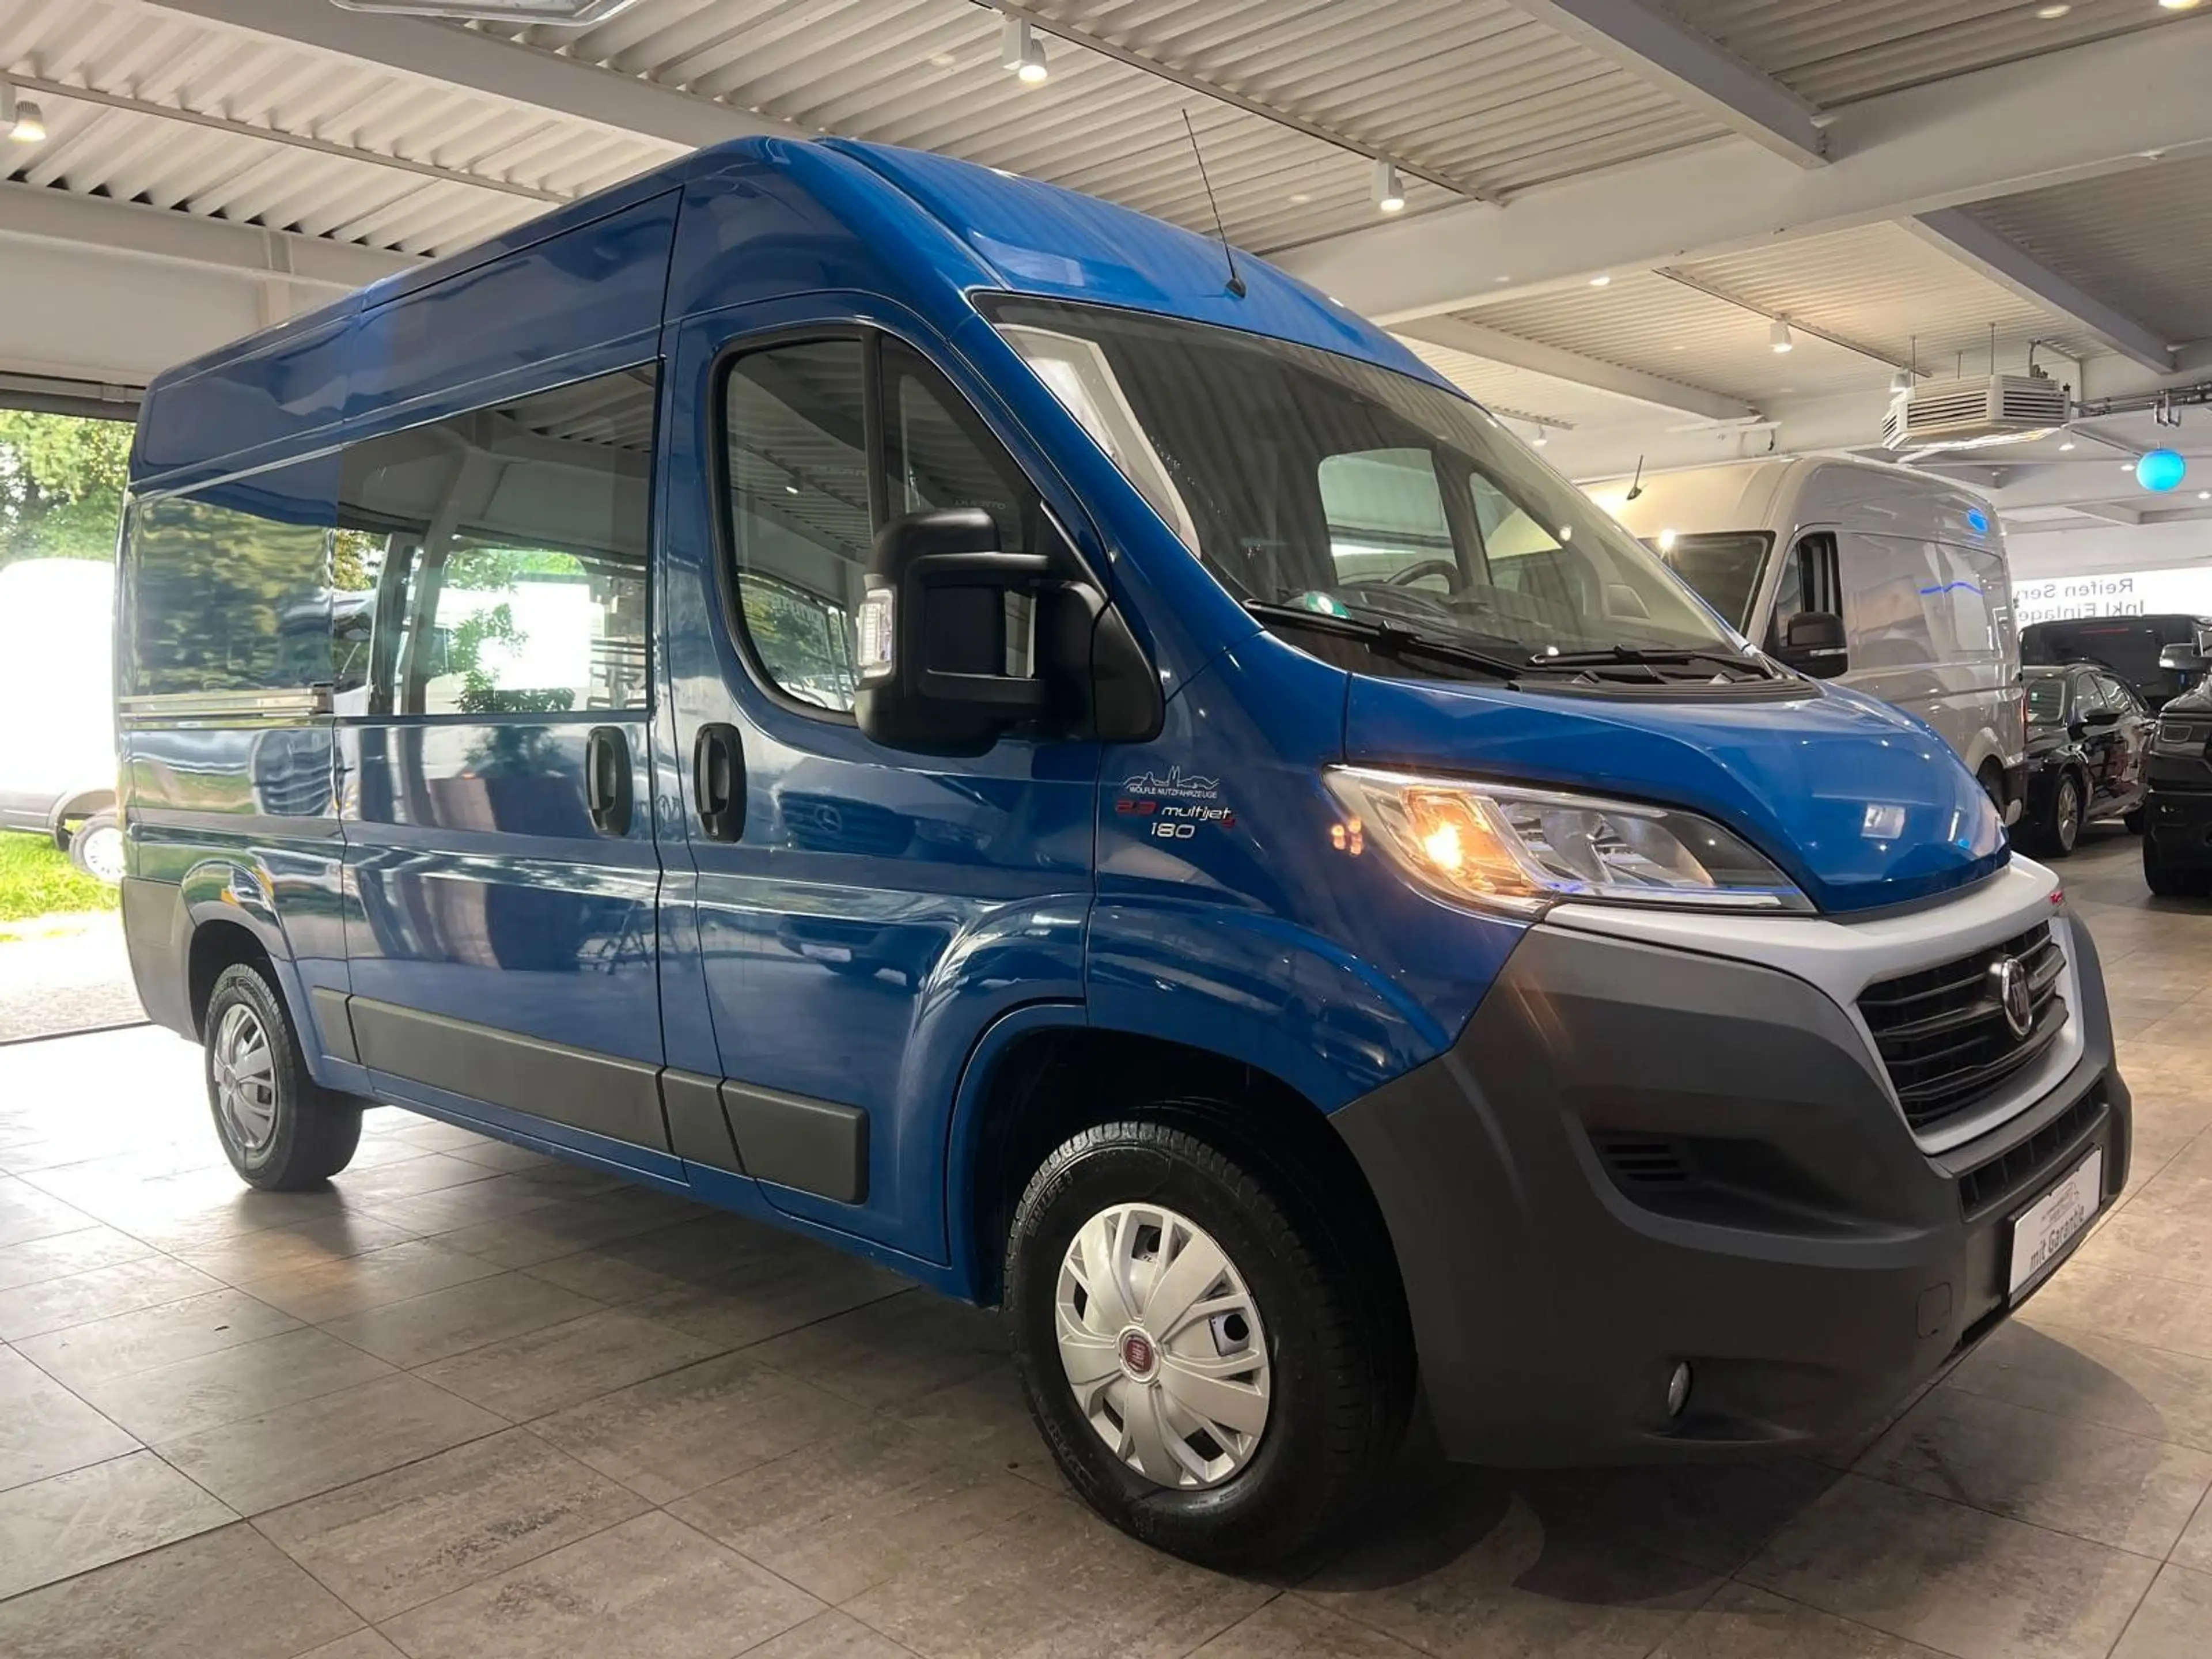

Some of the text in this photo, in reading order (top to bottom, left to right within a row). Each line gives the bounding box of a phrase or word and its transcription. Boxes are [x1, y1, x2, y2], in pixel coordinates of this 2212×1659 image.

[1157, 787, 1217, 798] NUTZFAHRZEUGE
[1161, 805, 1232, 820] multijet
[1152, 823, 1195, 839] 180
[2029, 1205, 2085, 1272] mit Garantie
